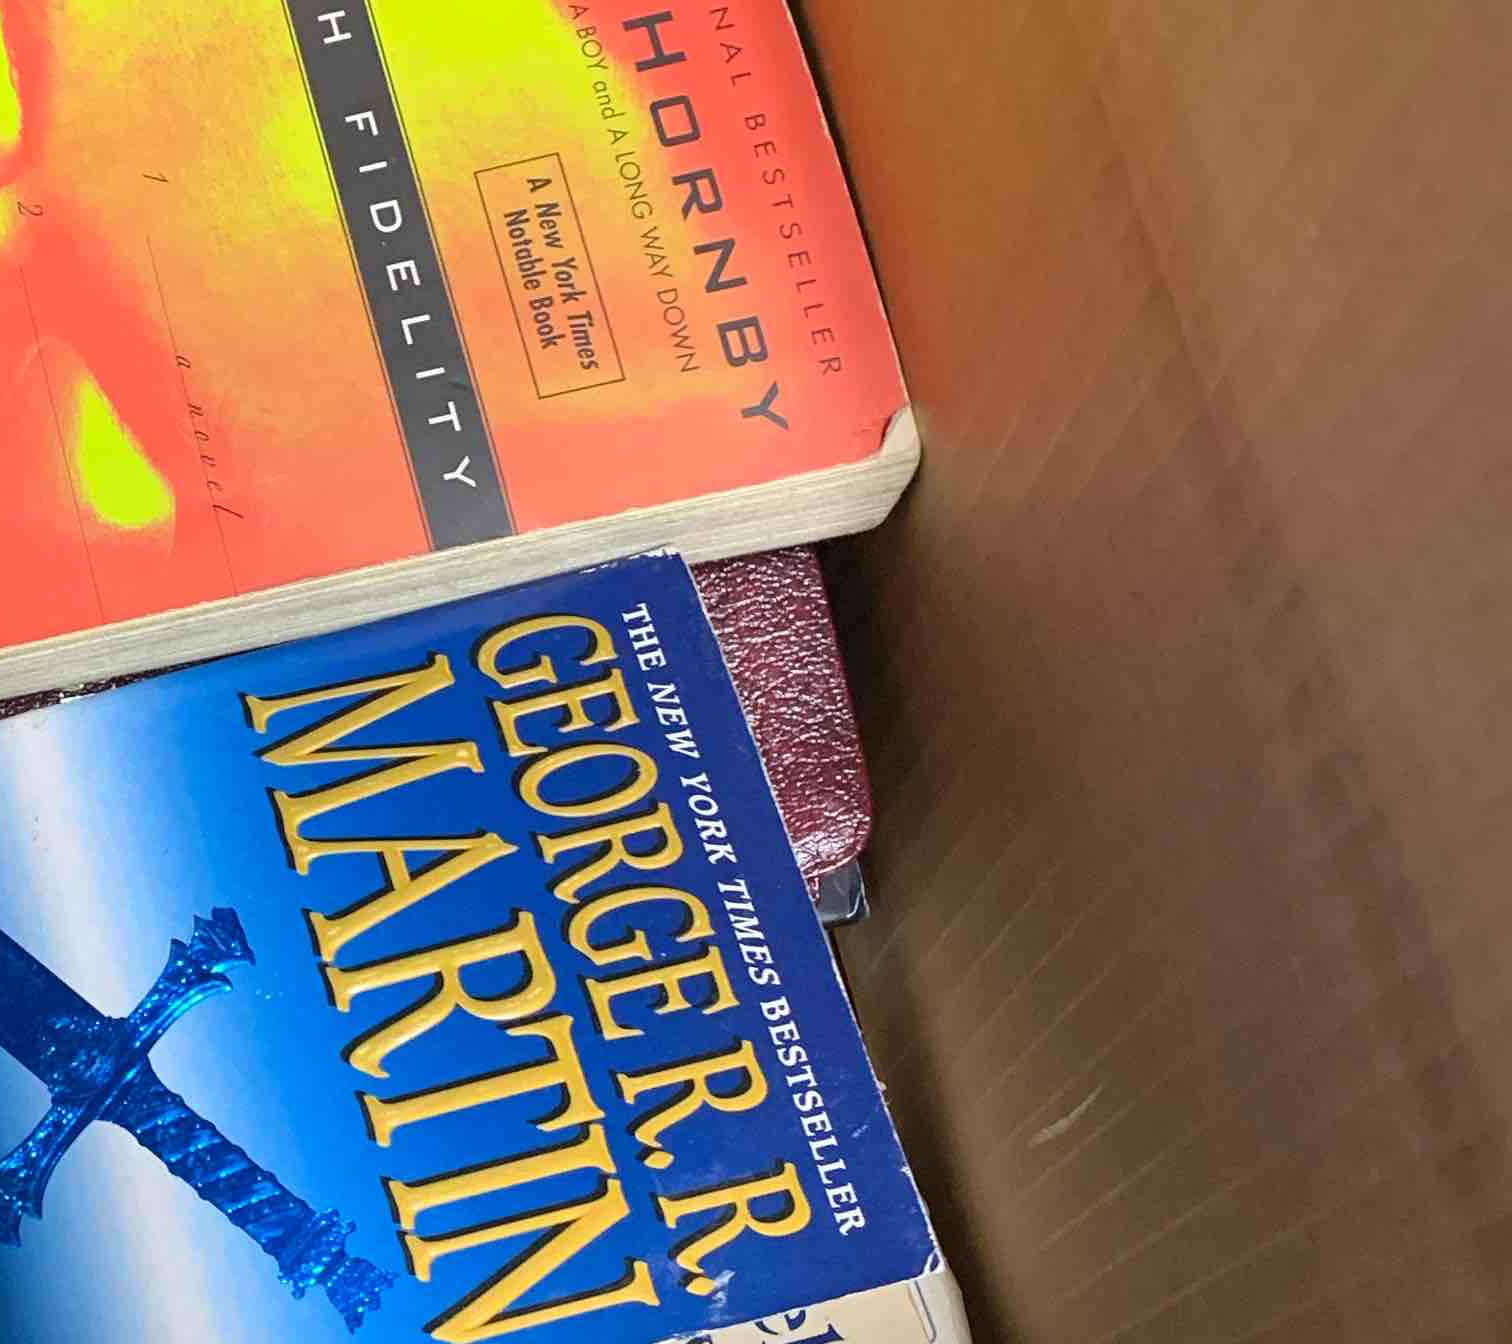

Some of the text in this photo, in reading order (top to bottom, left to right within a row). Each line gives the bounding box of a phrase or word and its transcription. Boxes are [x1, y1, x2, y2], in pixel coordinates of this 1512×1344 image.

[567, 4, 589, 21] A
[576, 23, 607, 73] BOY
[592, 79, 623, 120] and
[607, 128, 628, 145] A
[16, 199, 44, 217] 2
[616, 152, 655, 221] LONG
[621, 10, 790, 432] HORNBY
[344, 110, 478, 488] FIDELITY
[504, 208, 562, 351] Notable Book
[525, 176, 600, 373] A New York Times
[640, 225, 674, 280] WAY
[745, 112, 842, 377] BESTSELLER
[656, 289, 701, 374] DOWN
[175, 354, 245, 521] a novel
[471, 611, 813, 1296] GEORGE R. R.
[619, 602, 867, 1238] THE NEW YORK TIMES BESTSELLER
